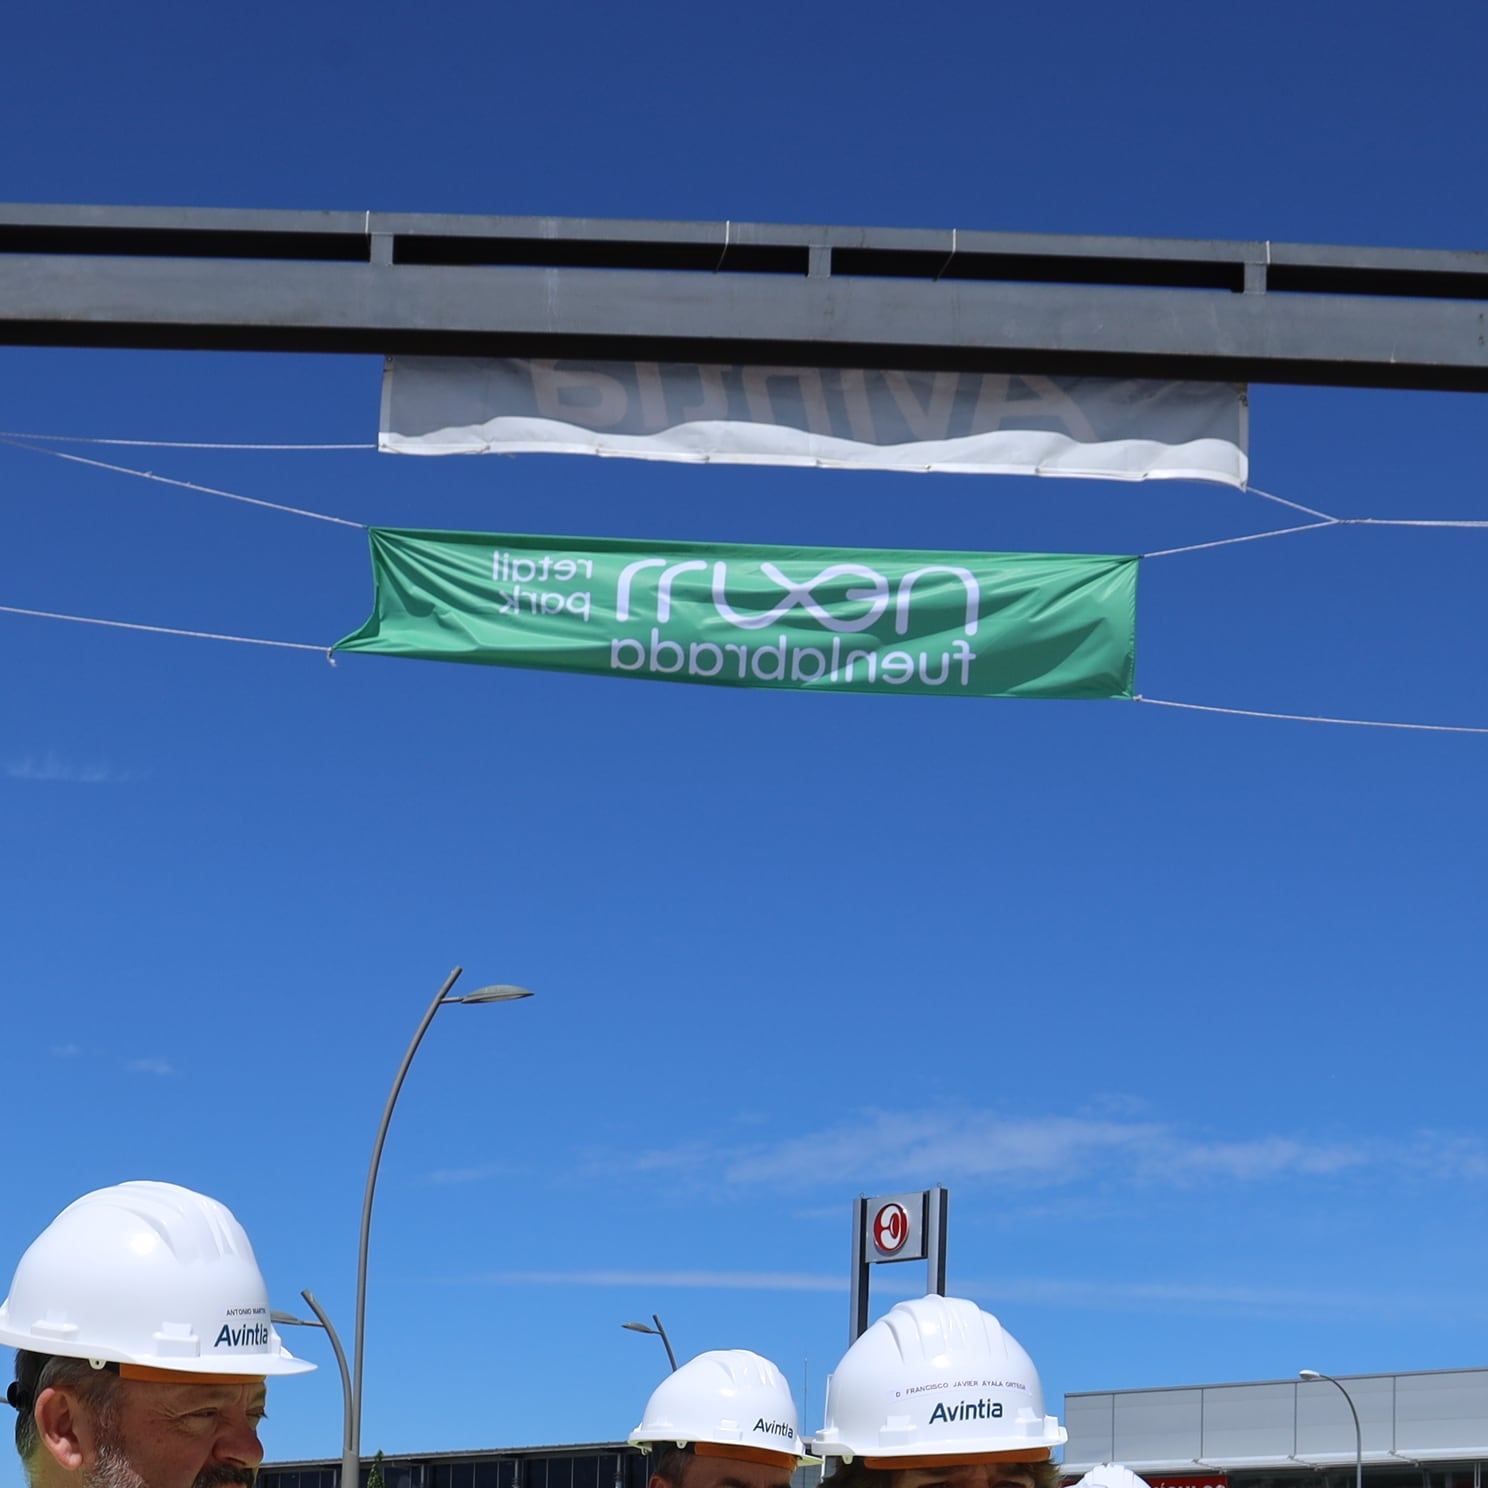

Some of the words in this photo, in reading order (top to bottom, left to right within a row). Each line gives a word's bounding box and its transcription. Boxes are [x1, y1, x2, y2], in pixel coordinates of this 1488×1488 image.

[214, 1322, 269, 1347] Avintia
[906, 1382, 949, 1395] FRANCISCO
[953, 1380, 979, 1388] JAVIER
[928, 1398, 1004, 1425] Avintia
[752, 1418, 794, 1439] Avintia
